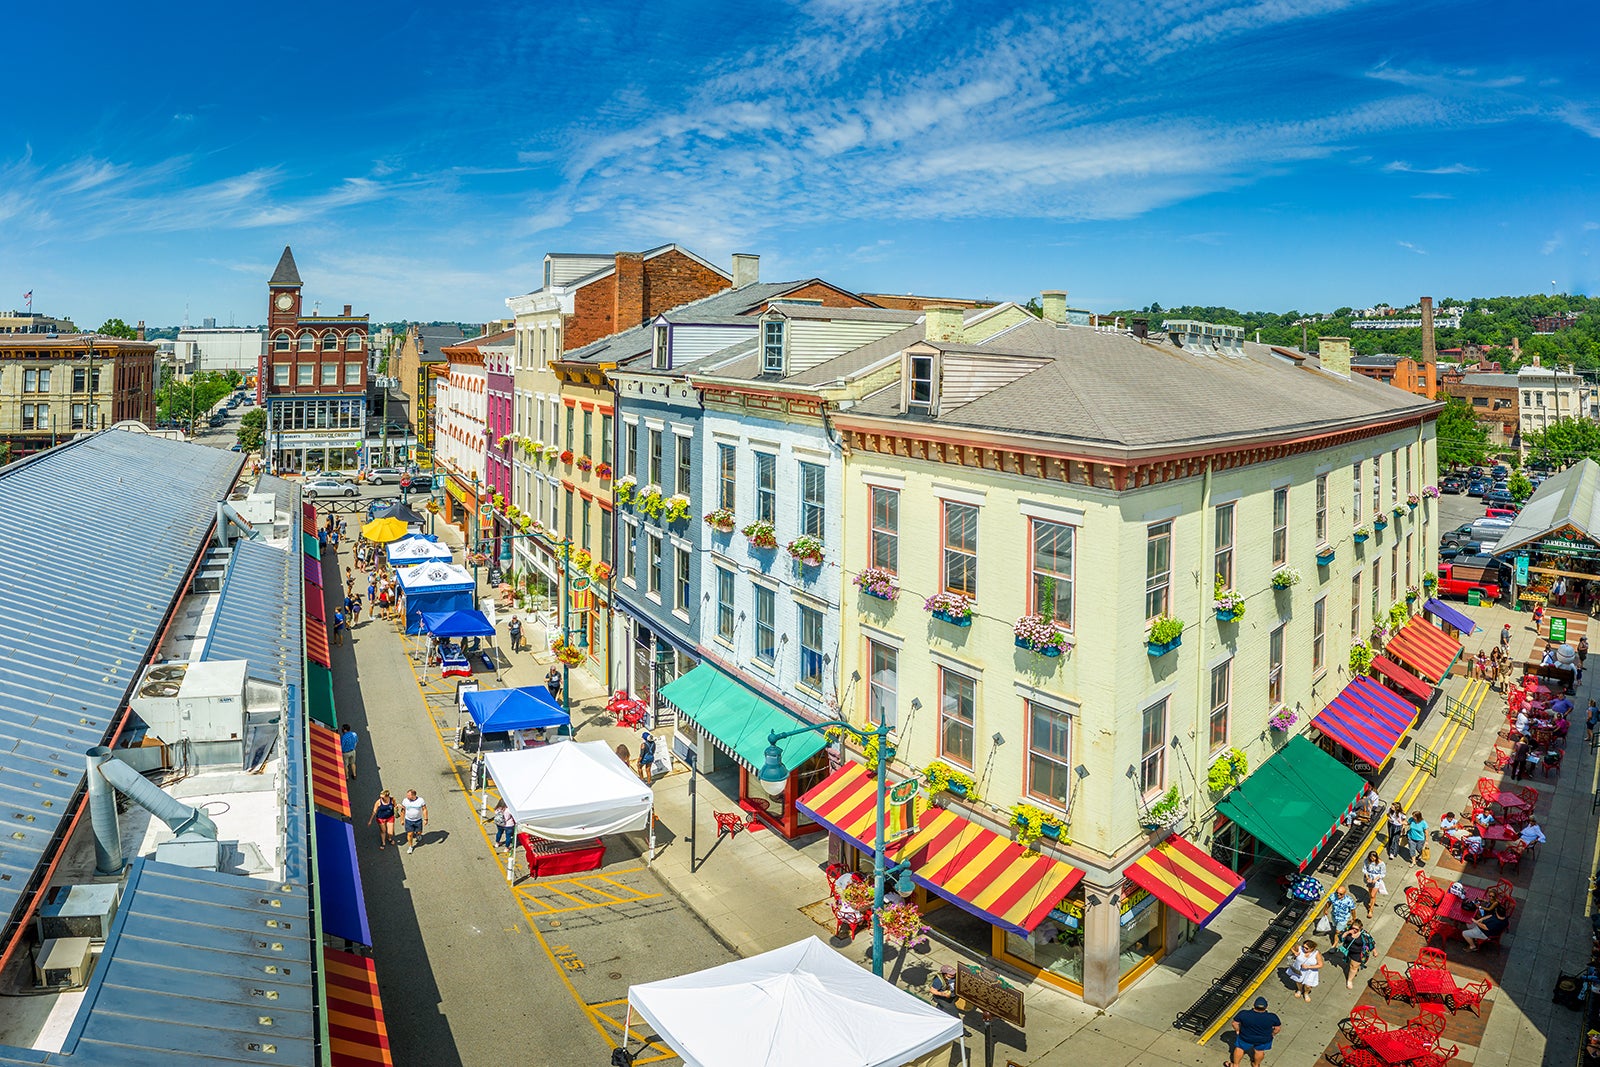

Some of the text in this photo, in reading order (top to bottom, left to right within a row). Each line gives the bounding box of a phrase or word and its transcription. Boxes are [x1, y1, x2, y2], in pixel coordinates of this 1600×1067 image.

[417, 373, 425, 443] LEADER
[1543, 540, 1595, 550] FARMERS MARKET
